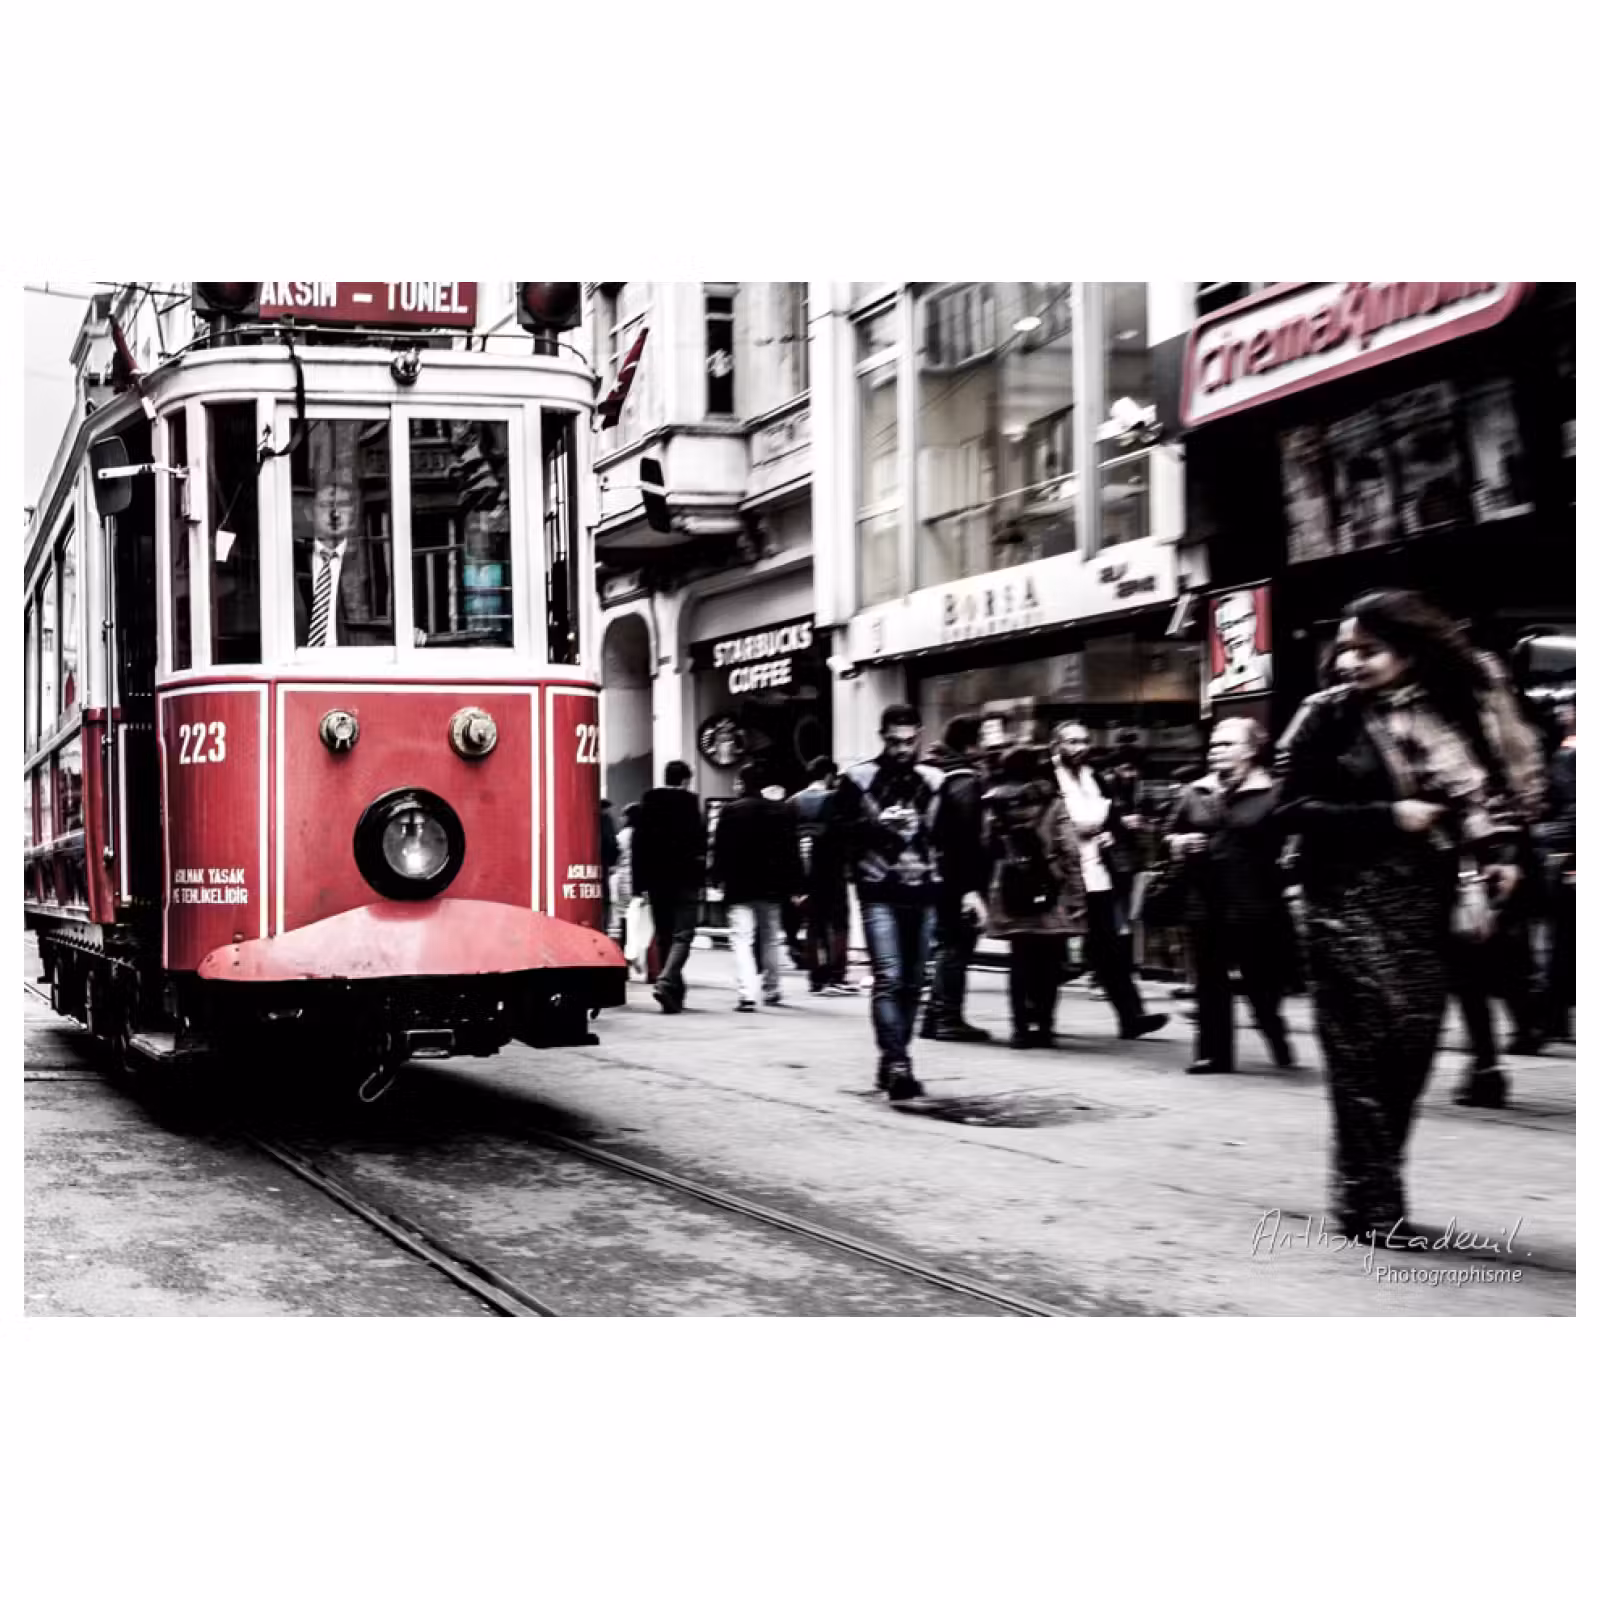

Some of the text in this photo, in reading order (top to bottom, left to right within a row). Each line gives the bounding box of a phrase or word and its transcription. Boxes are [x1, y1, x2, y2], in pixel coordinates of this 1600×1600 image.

[713, 621, 813, 668] STARBUCKS
[728, 657, 793, 695] COFFEE
[179, 721, 227, 764] 223
[575, 722, 601, 763] 22
[208, 868, 245, 884] YASAK
[562, 883, 577, 899] VE
